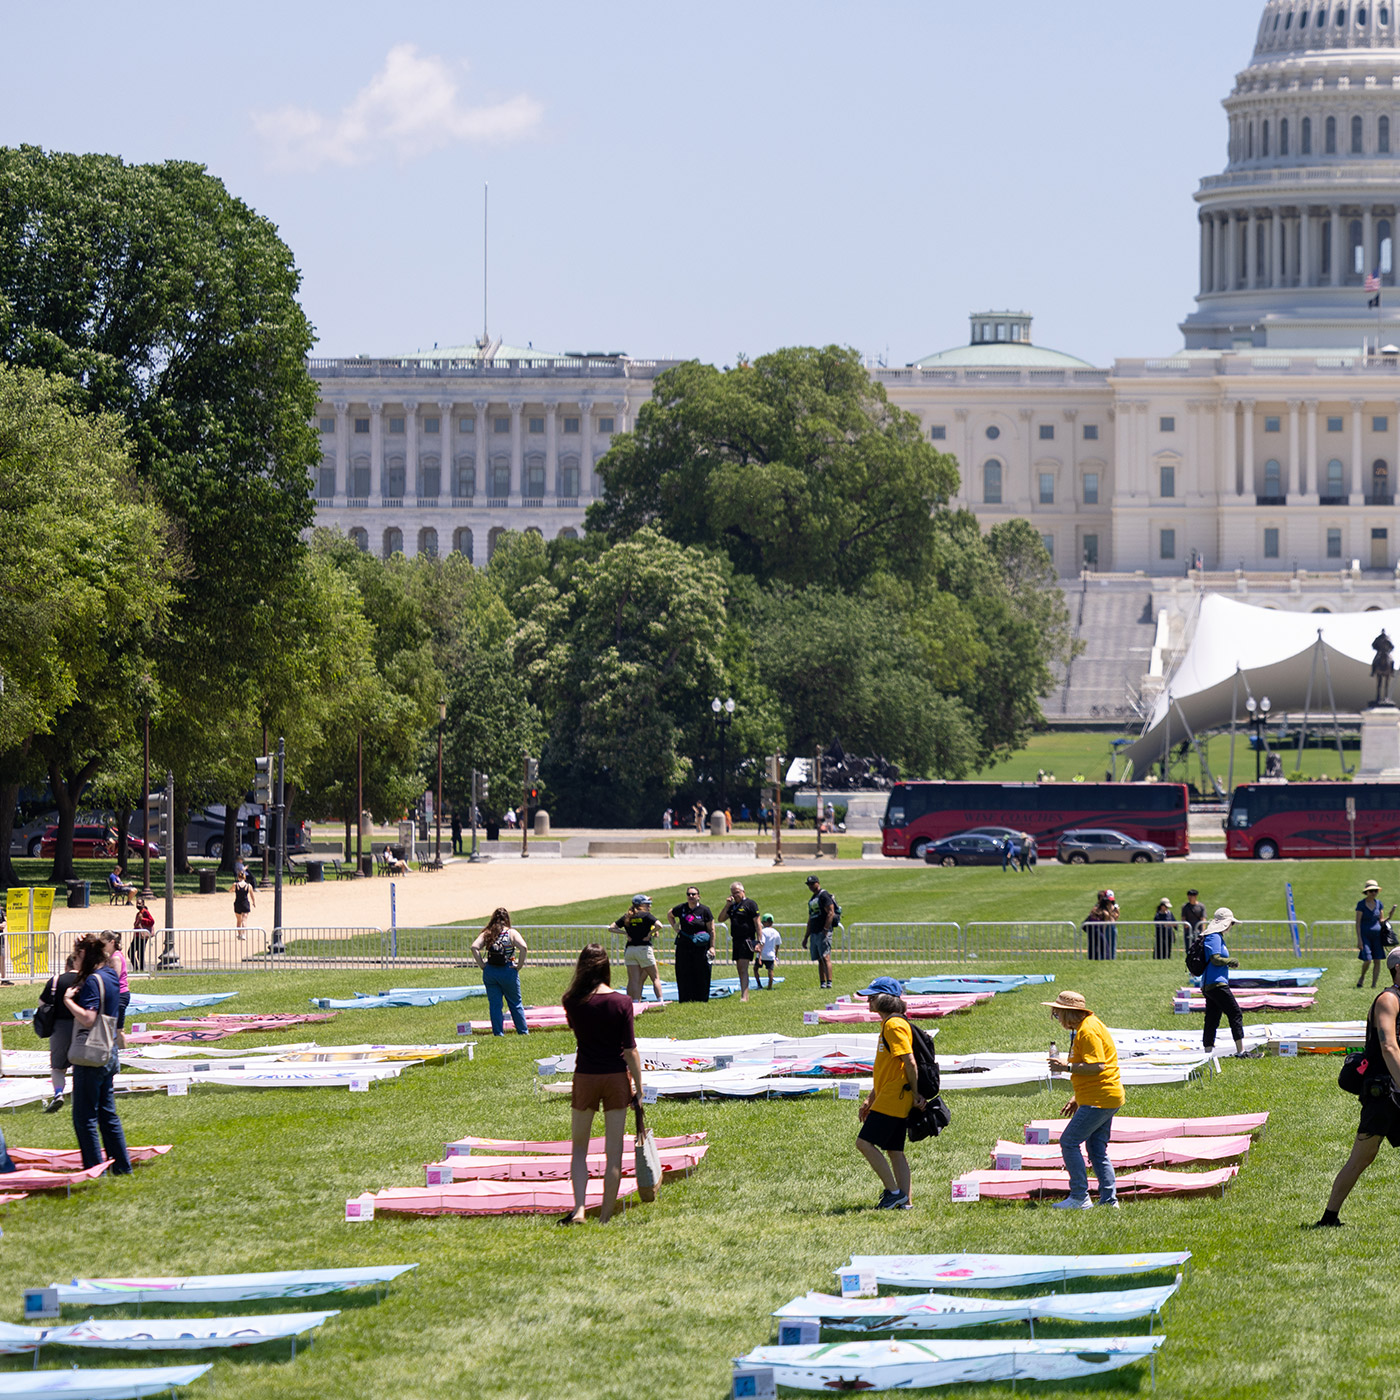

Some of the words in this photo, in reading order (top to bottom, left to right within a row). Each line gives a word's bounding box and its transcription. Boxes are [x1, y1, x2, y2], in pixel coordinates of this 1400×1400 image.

[964, 813, 995, 822] WISE
[1000, 812, 1064, 822] COACHES
[1306, 813, 1339, 822] WISE
